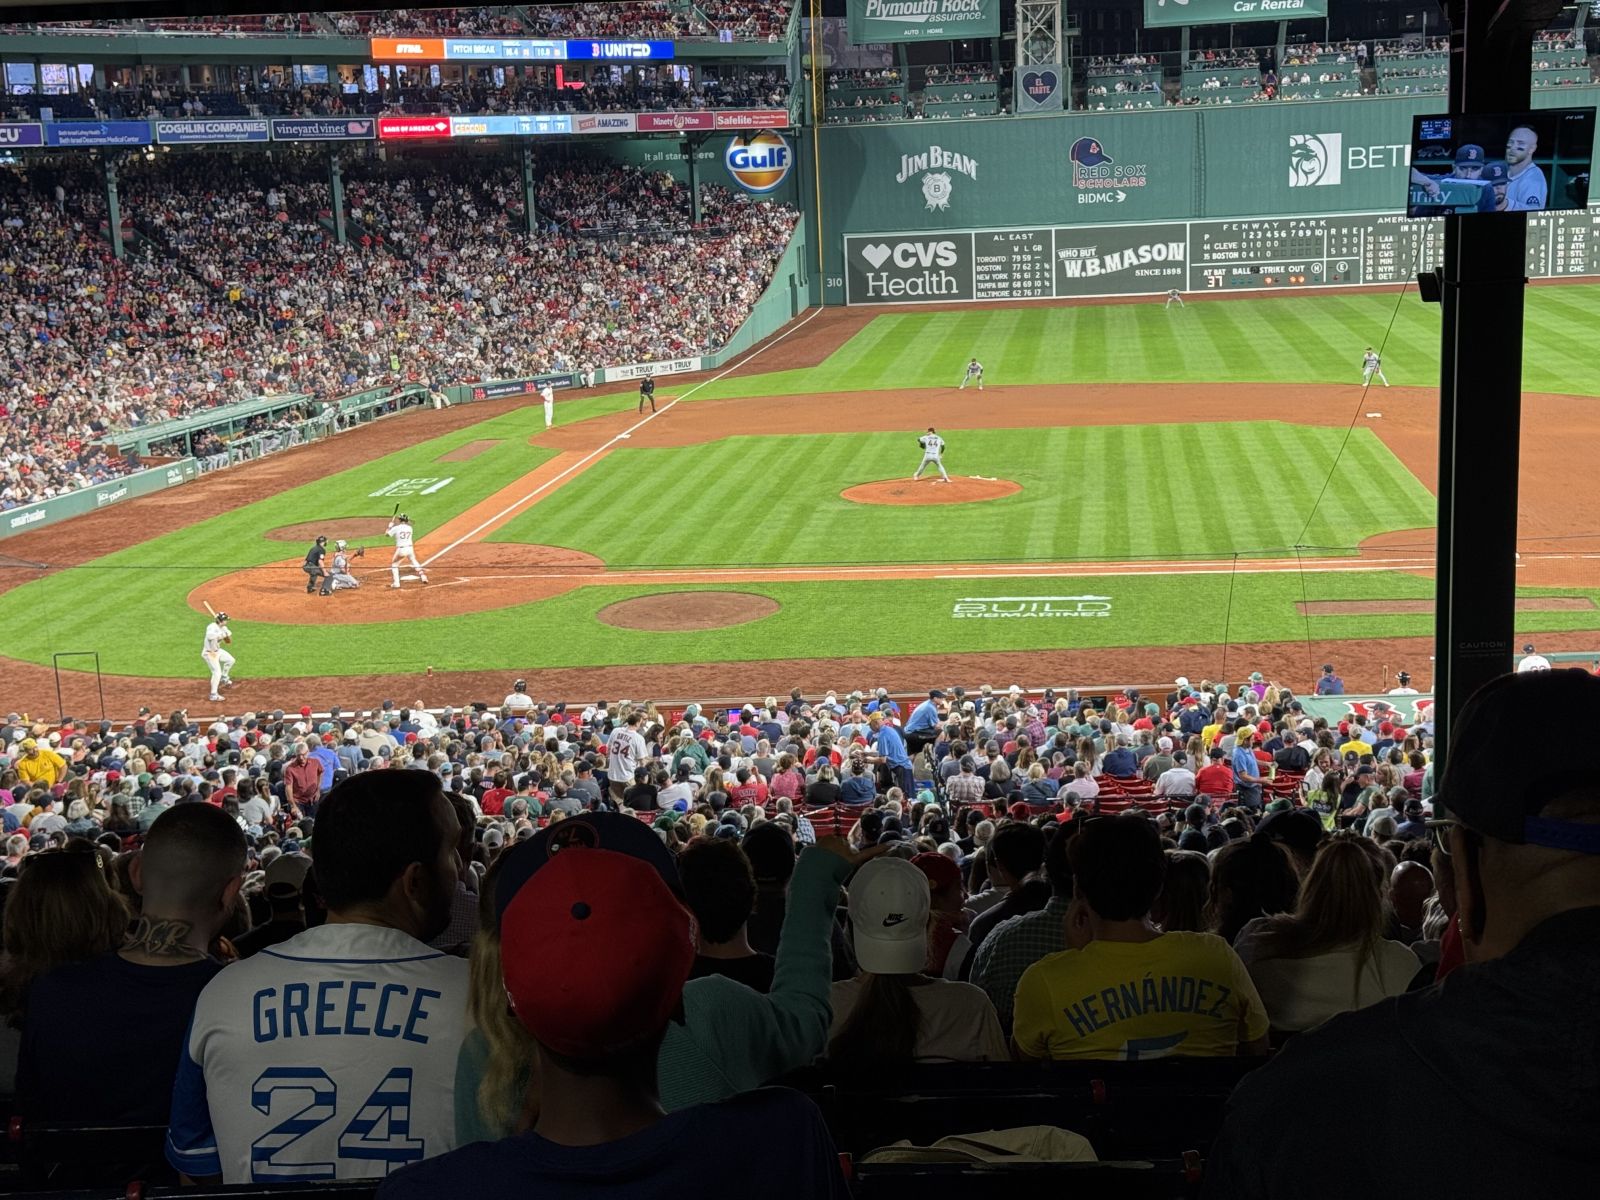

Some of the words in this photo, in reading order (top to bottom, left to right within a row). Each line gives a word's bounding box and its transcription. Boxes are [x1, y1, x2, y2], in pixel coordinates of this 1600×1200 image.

[866, 0, 940, 17] Plymouth
[1233, 1, 1254, 12] Car
[1261, 0, 1304, 10] Rental
[929, 11, 982, 22] assurance
[605, 43, 651, 57] UNITED
[597, 118, 629, 128] AMAZING
[653, 118, 673, 126] Ninety
[685, 116, 699, 125] Nine
[718, 116, 752, 125] Safelite
[159, 124, 205, 133] COGHLIN
[206, 123, 267, 132] COMPANIES
[276, 123, 319, 137] vineyard
[319, 124, 346, 133] vines
[644, 153, 652, 161] It
[653, 151, 663, 160] all
[729, 147, 787, 169] Gulf
[896, 152, 928, 184] JIM
[930, 145, 977, 181] BEAM
[1078, 166, 1109, 178] RED
[1115, 164, 1146, 177] SOX
[1078, 177, 1147, 189] SCHOLARS
[1078, 192, 1114, 204] BIDMC
[1223, 222, 1279, 230] FENWAY
[1290, 220, 1326, 228] PARK
[1214, 242, 1238, 250] CLEVE
[893, 241, 957, 268] CVS
[1058, 249, 1078, 259] WHO
[1079, 248, 1096, 257] BUT
[1135, 268, 1161, 276] SINCE
[1162, 267, 1181, 275] 1898
[1260, 266, 1285, 274] STRIKE
[826, 278, 843, 287] 310
[866, 270, 959, 296] Health
[1208, 276, 1222, 287] 37
[635, 365, 654, 374] TRULY
[674, 361, 692, 369] TRULY
[928, 439, 938, 447] 44
[400, 531, 411, 539] 37
[953, 602, 1112, 613] BUILD
[611, 741, 631, 758] 34
[1063, 971, 1231, 1037] HERNÁNDEZ
[253, 980, 441, 1044] GREECE
[251, 1066, 425, 1183] 24
